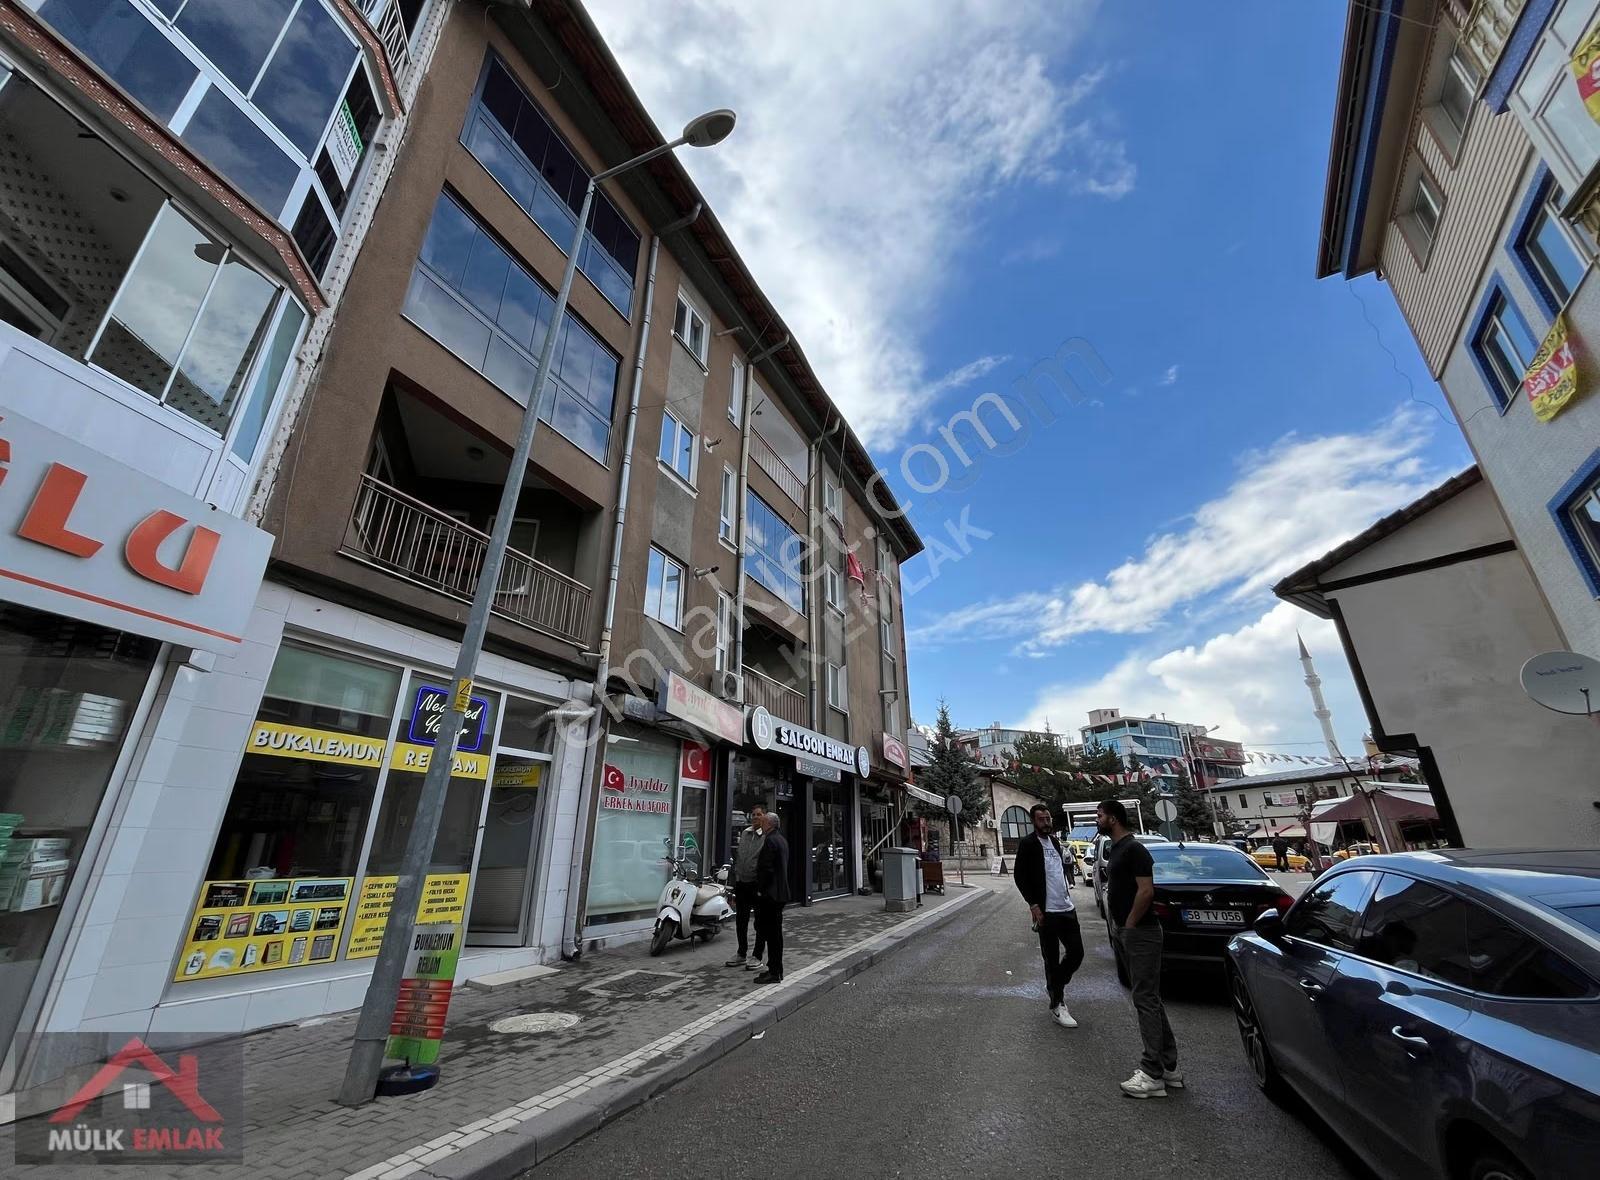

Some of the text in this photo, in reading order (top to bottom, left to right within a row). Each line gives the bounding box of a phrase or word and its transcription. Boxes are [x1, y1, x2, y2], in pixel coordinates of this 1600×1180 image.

[0, 416, 222, 596] LU
[253, 730, 478, 774] BUKALEMUN REAM
[779, 726, 825, 756] SALOON
[826, 744, 855, 766] EMRAH
[604, 795, 633, 811] ERKEK
[1187, 910, 1241, 921] 58 TV 056
[413, 932, 455, 951] BUKALEMUN
